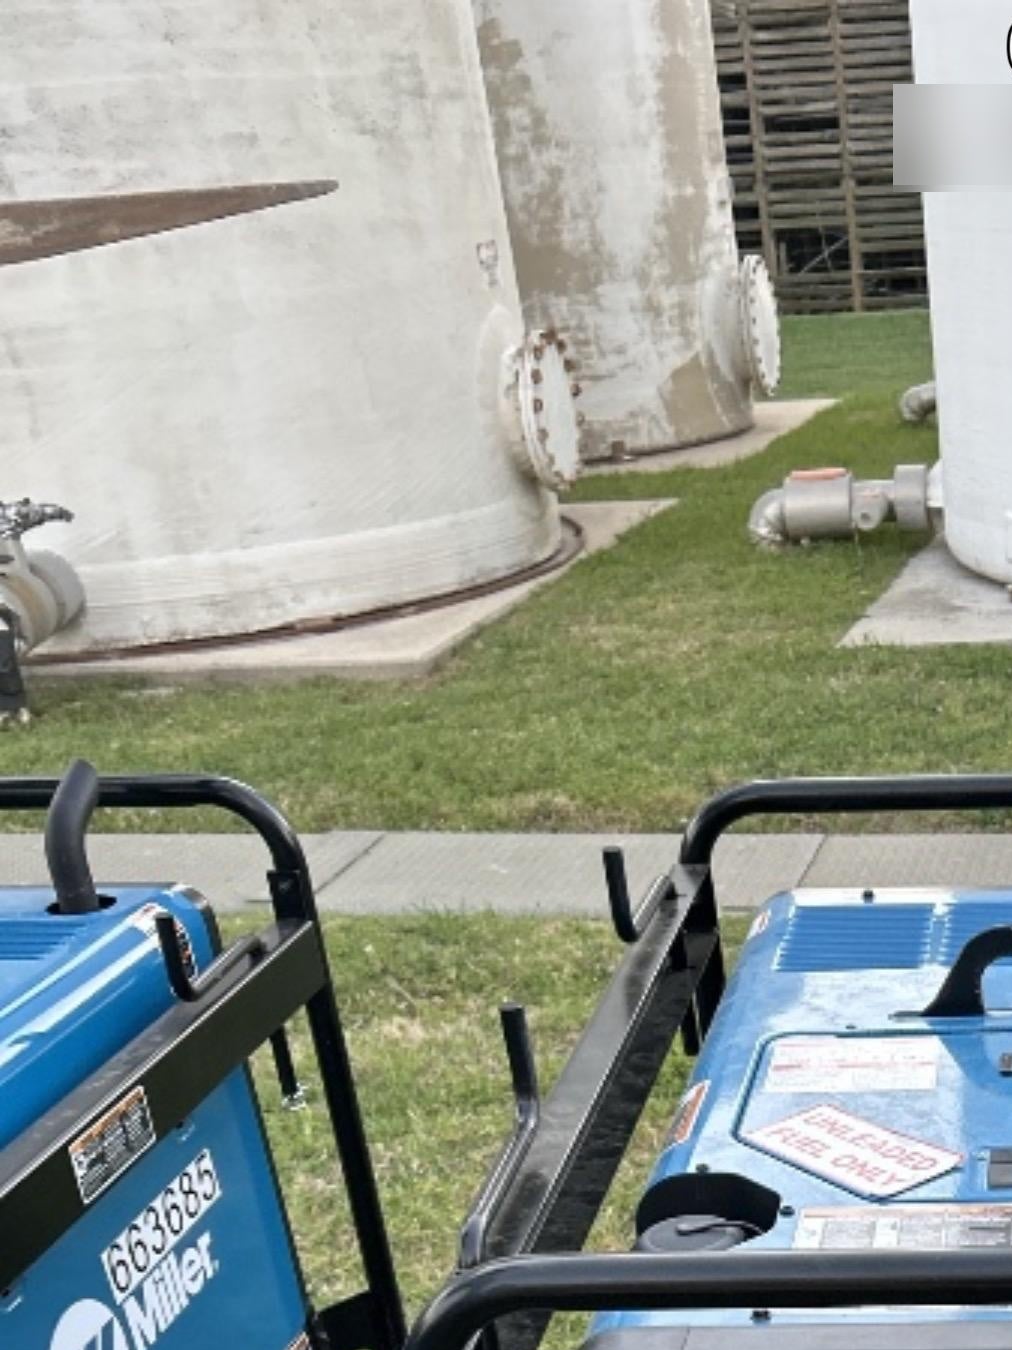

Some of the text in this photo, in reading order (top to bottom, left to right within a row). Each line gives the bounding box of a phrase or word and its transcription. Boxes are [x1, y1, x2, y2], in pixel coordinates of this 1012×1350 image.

[766, 1127, 905, 1186] FUEL ONLY
[803, 1112, 938, 1171] UNLEADED
[107, 1152, 217, 1293] 663685
